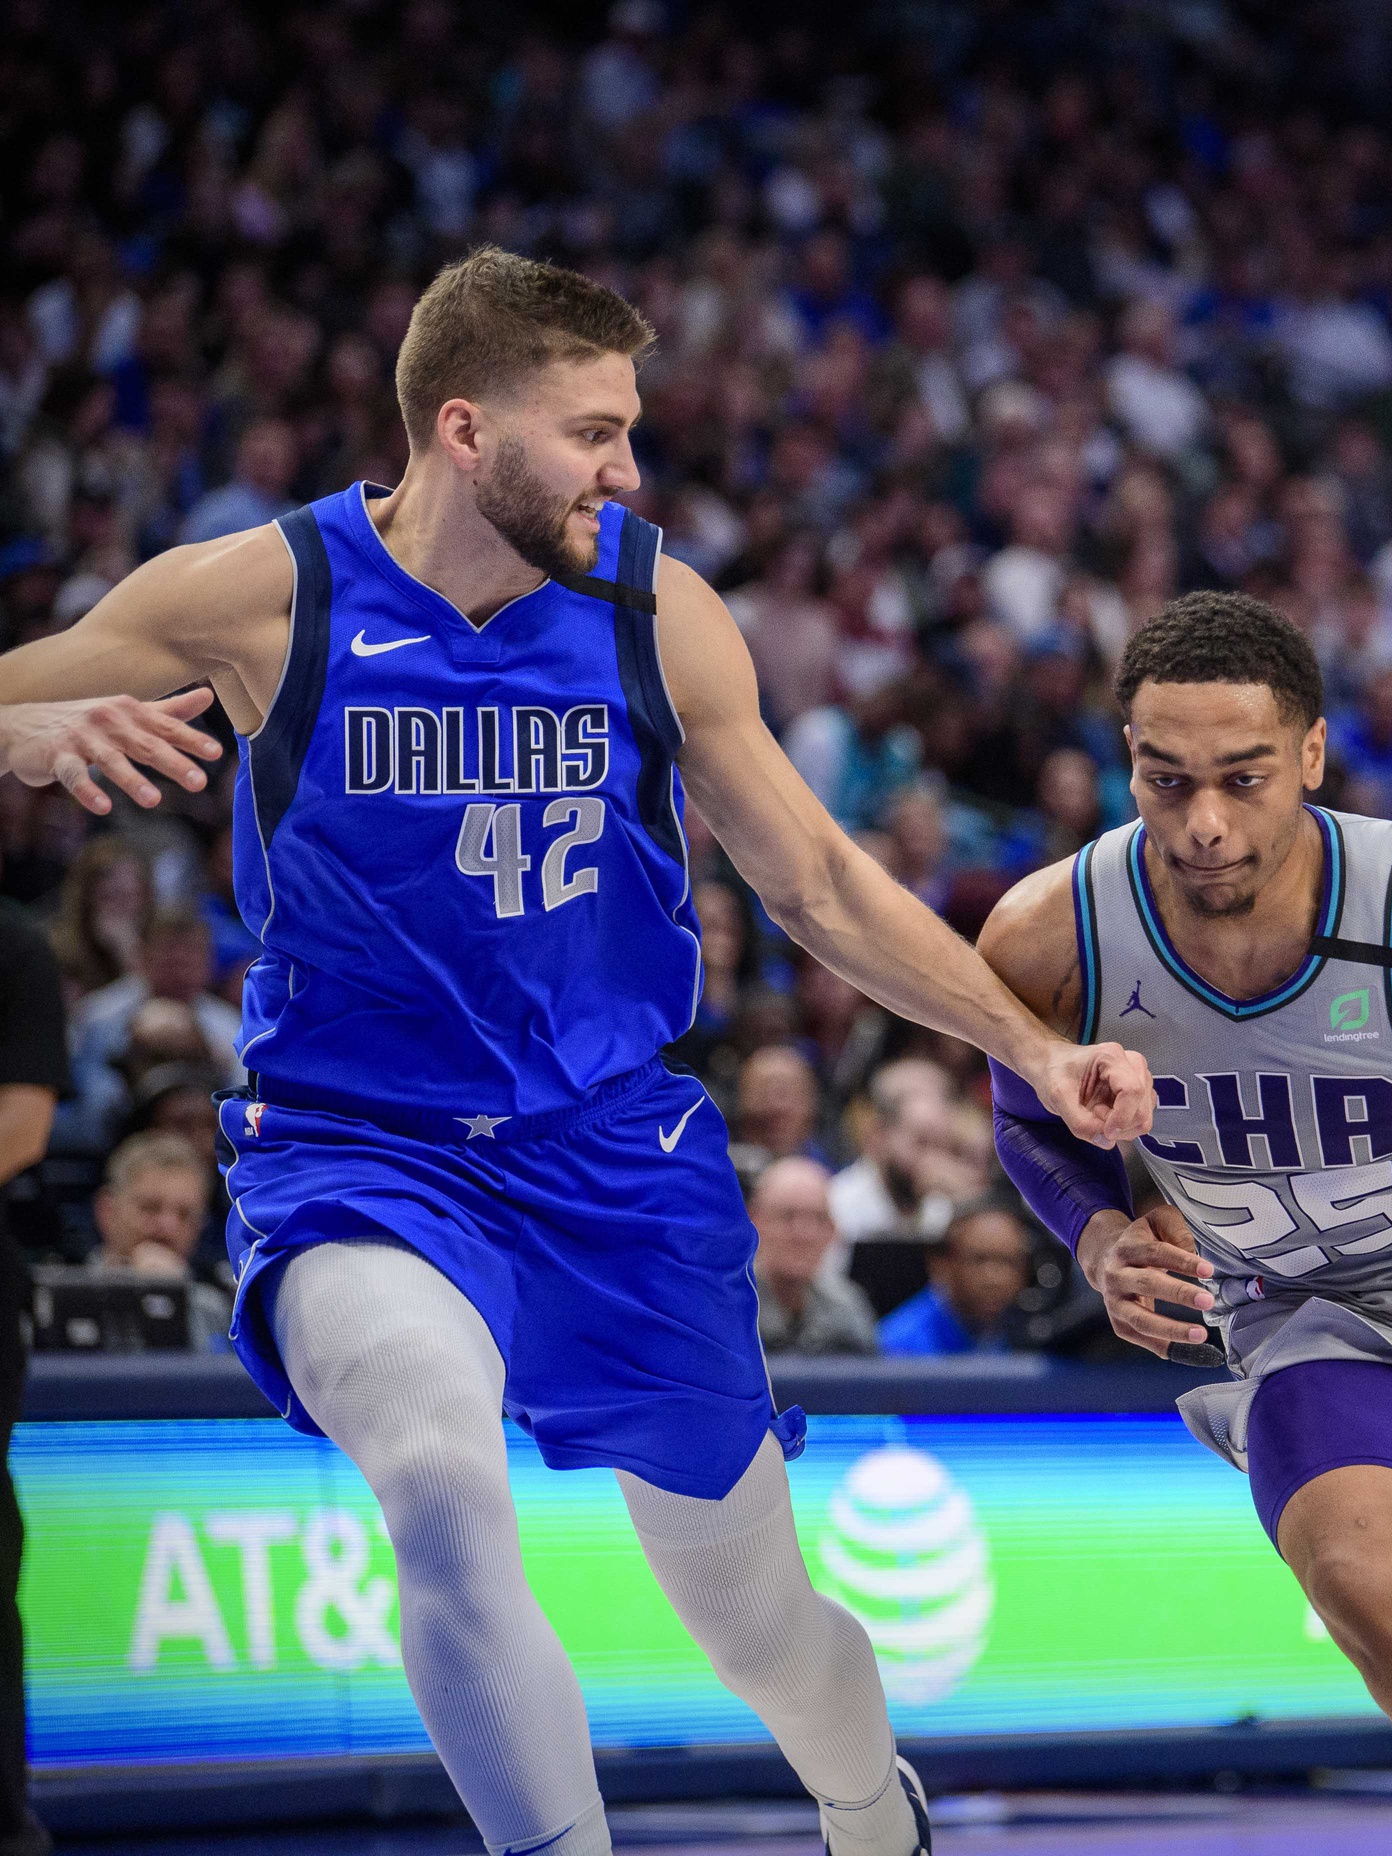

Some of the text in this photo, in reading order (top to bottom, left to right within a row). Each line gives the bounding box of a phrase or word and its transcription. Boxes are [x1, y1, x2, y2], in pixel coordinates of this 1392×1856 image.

[344, 704, 610, 795] DALLAS
[454, 796, 606, 919] 42
[1323, 1031, 1380, 1043] lendingtree
[129, 1507, 402, 1675] AT&
